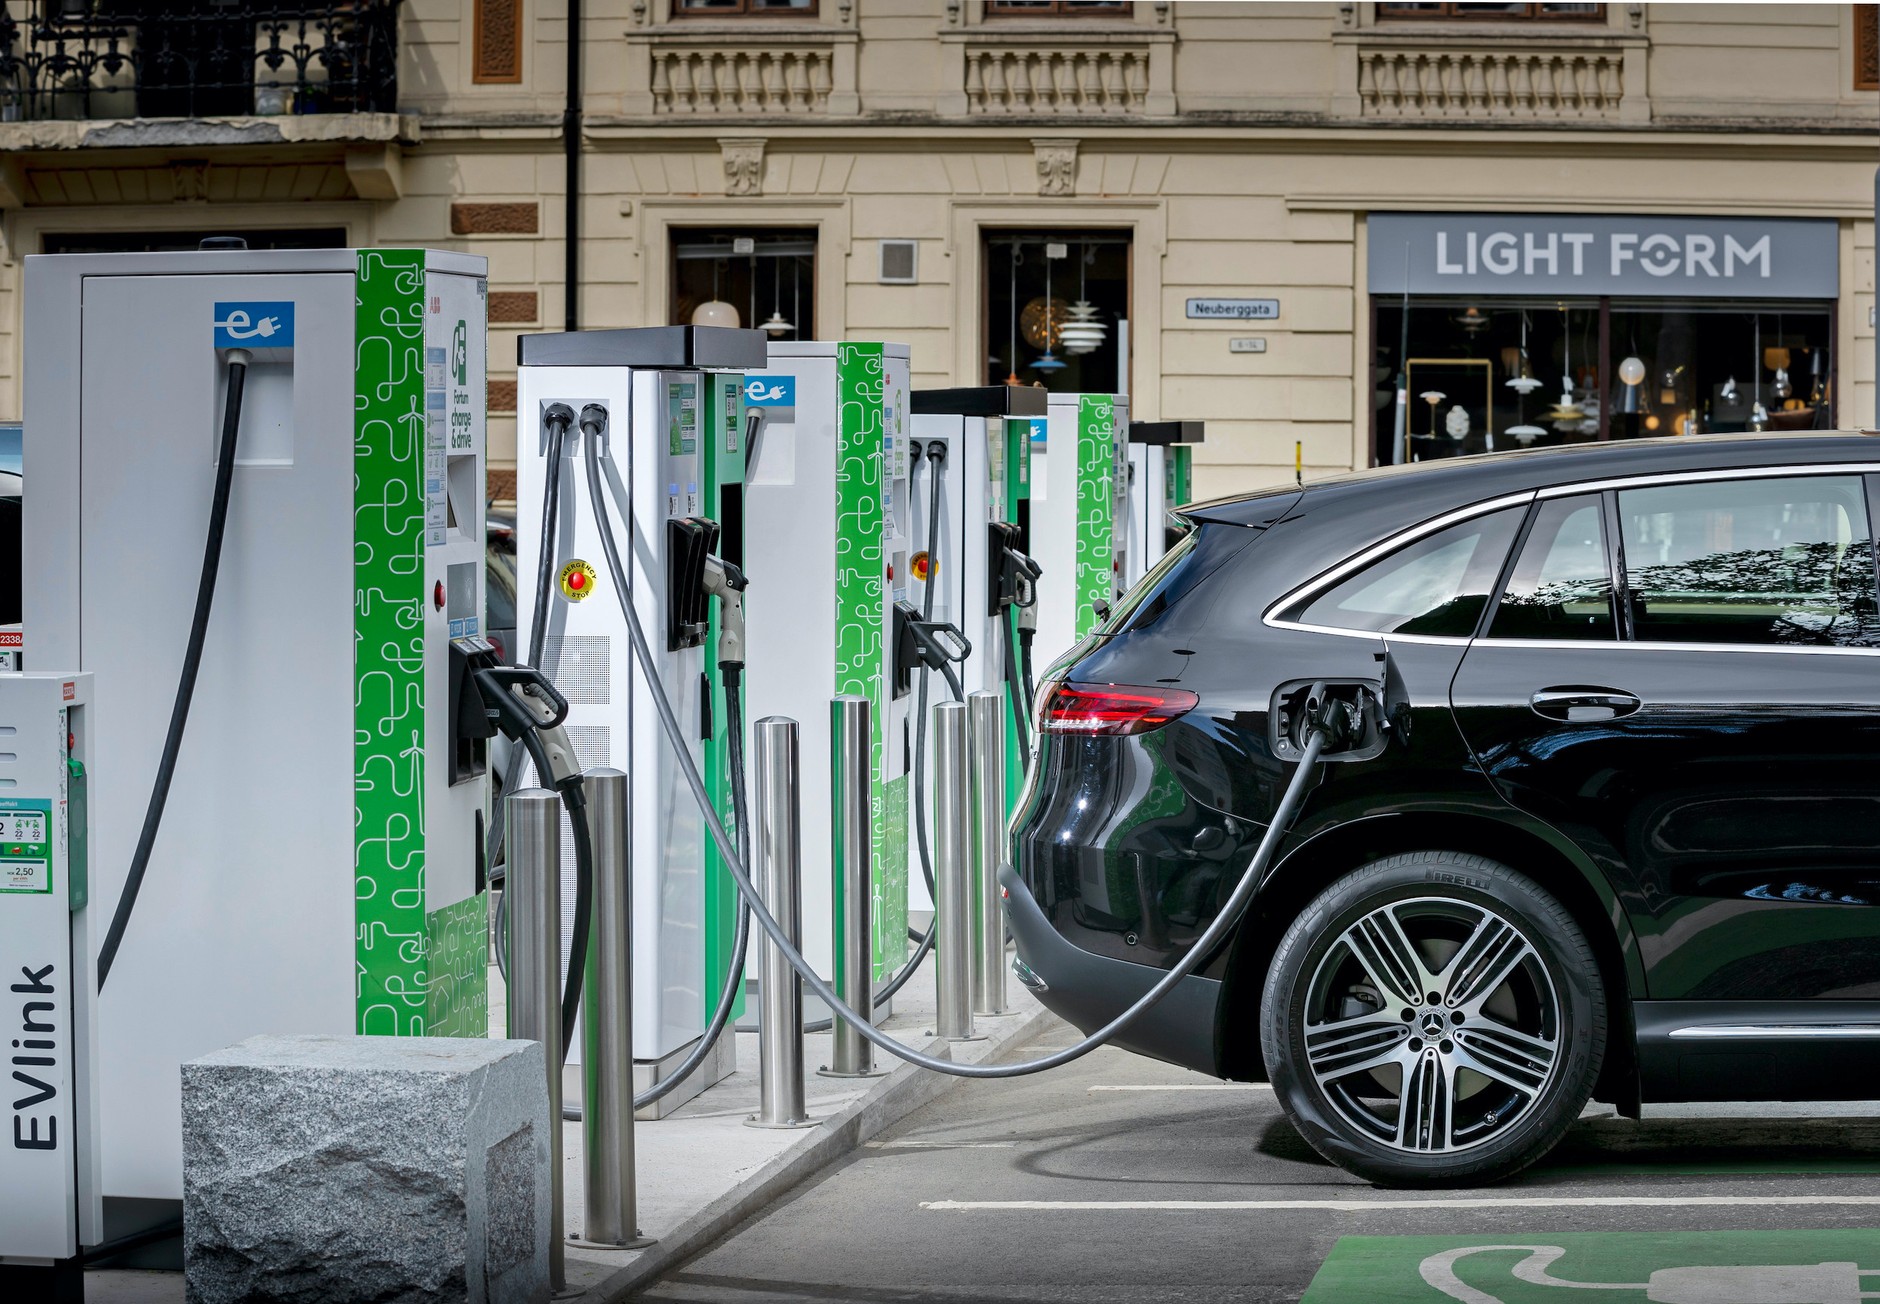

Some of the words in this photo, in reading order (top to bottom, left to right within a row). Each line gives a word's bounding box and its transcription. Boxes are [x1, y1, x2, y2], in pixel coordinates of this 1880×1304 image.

[1437, 232, 1594, 275] LIGHT
[1611, 233, 1770, 277] FORM
[430, 297, 441, 314] ABB
[1195, 303, 1270, 317] Neuberggata
[453, 389, 470, 405] Fortum
[451, 407, 472, 432] charge
[451, 428, 457, 449] &
[457, 430, 472, 449] drive
[562, 563, 597, 581] EMERGENCY
[16, 867, 33, 876] 2,50
[1425, 866, 1491, 890] PIRELLI
[10, 964, 57, 1150] EVlink
